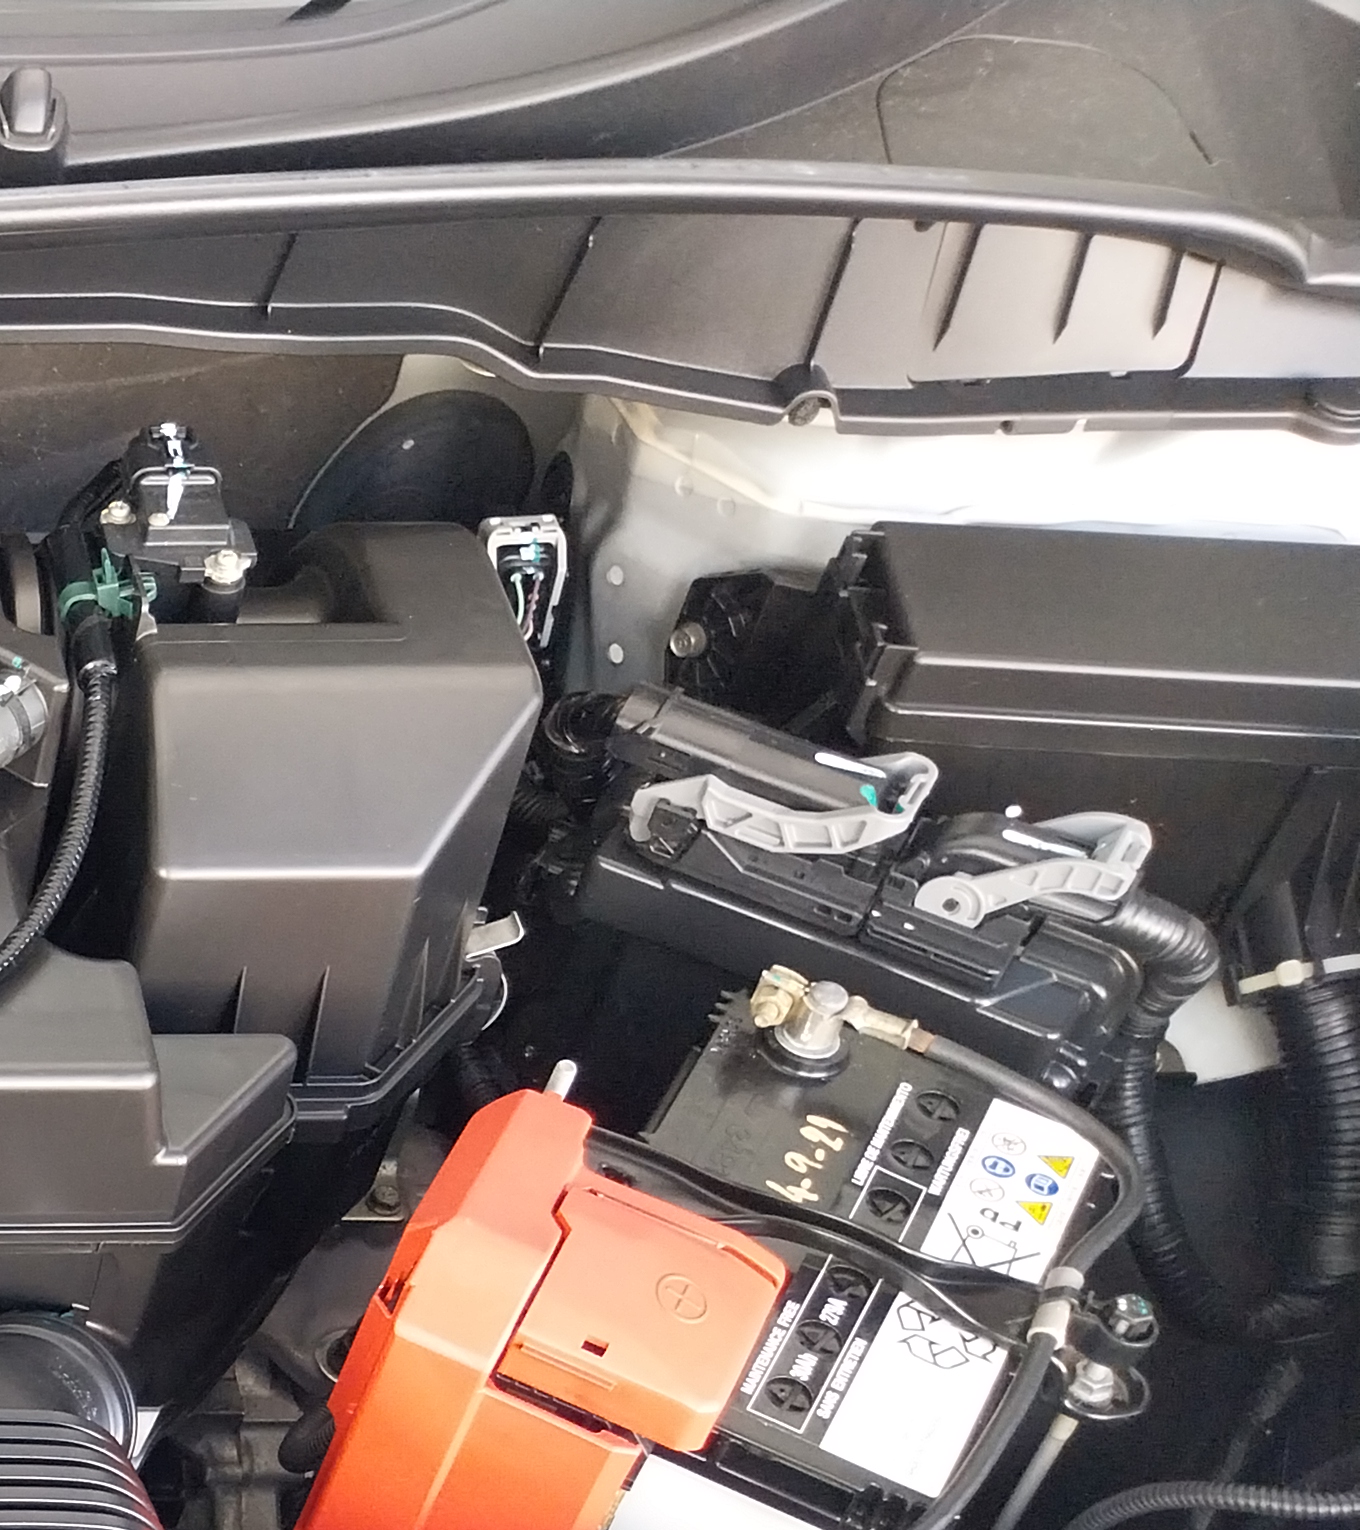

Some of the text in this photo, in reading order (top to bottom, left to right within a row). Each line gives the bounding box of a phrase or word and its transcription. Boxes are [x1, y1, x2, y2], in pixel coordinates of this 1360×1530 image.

[851, 1161, 872, 1187] LIBRE
[864, 1147, 880, 1162] DE
[740, 1299, 801, 1396] MAINTENANCE FREE
[816, 1337, 868, 1420] SANS ENTRETIEN
